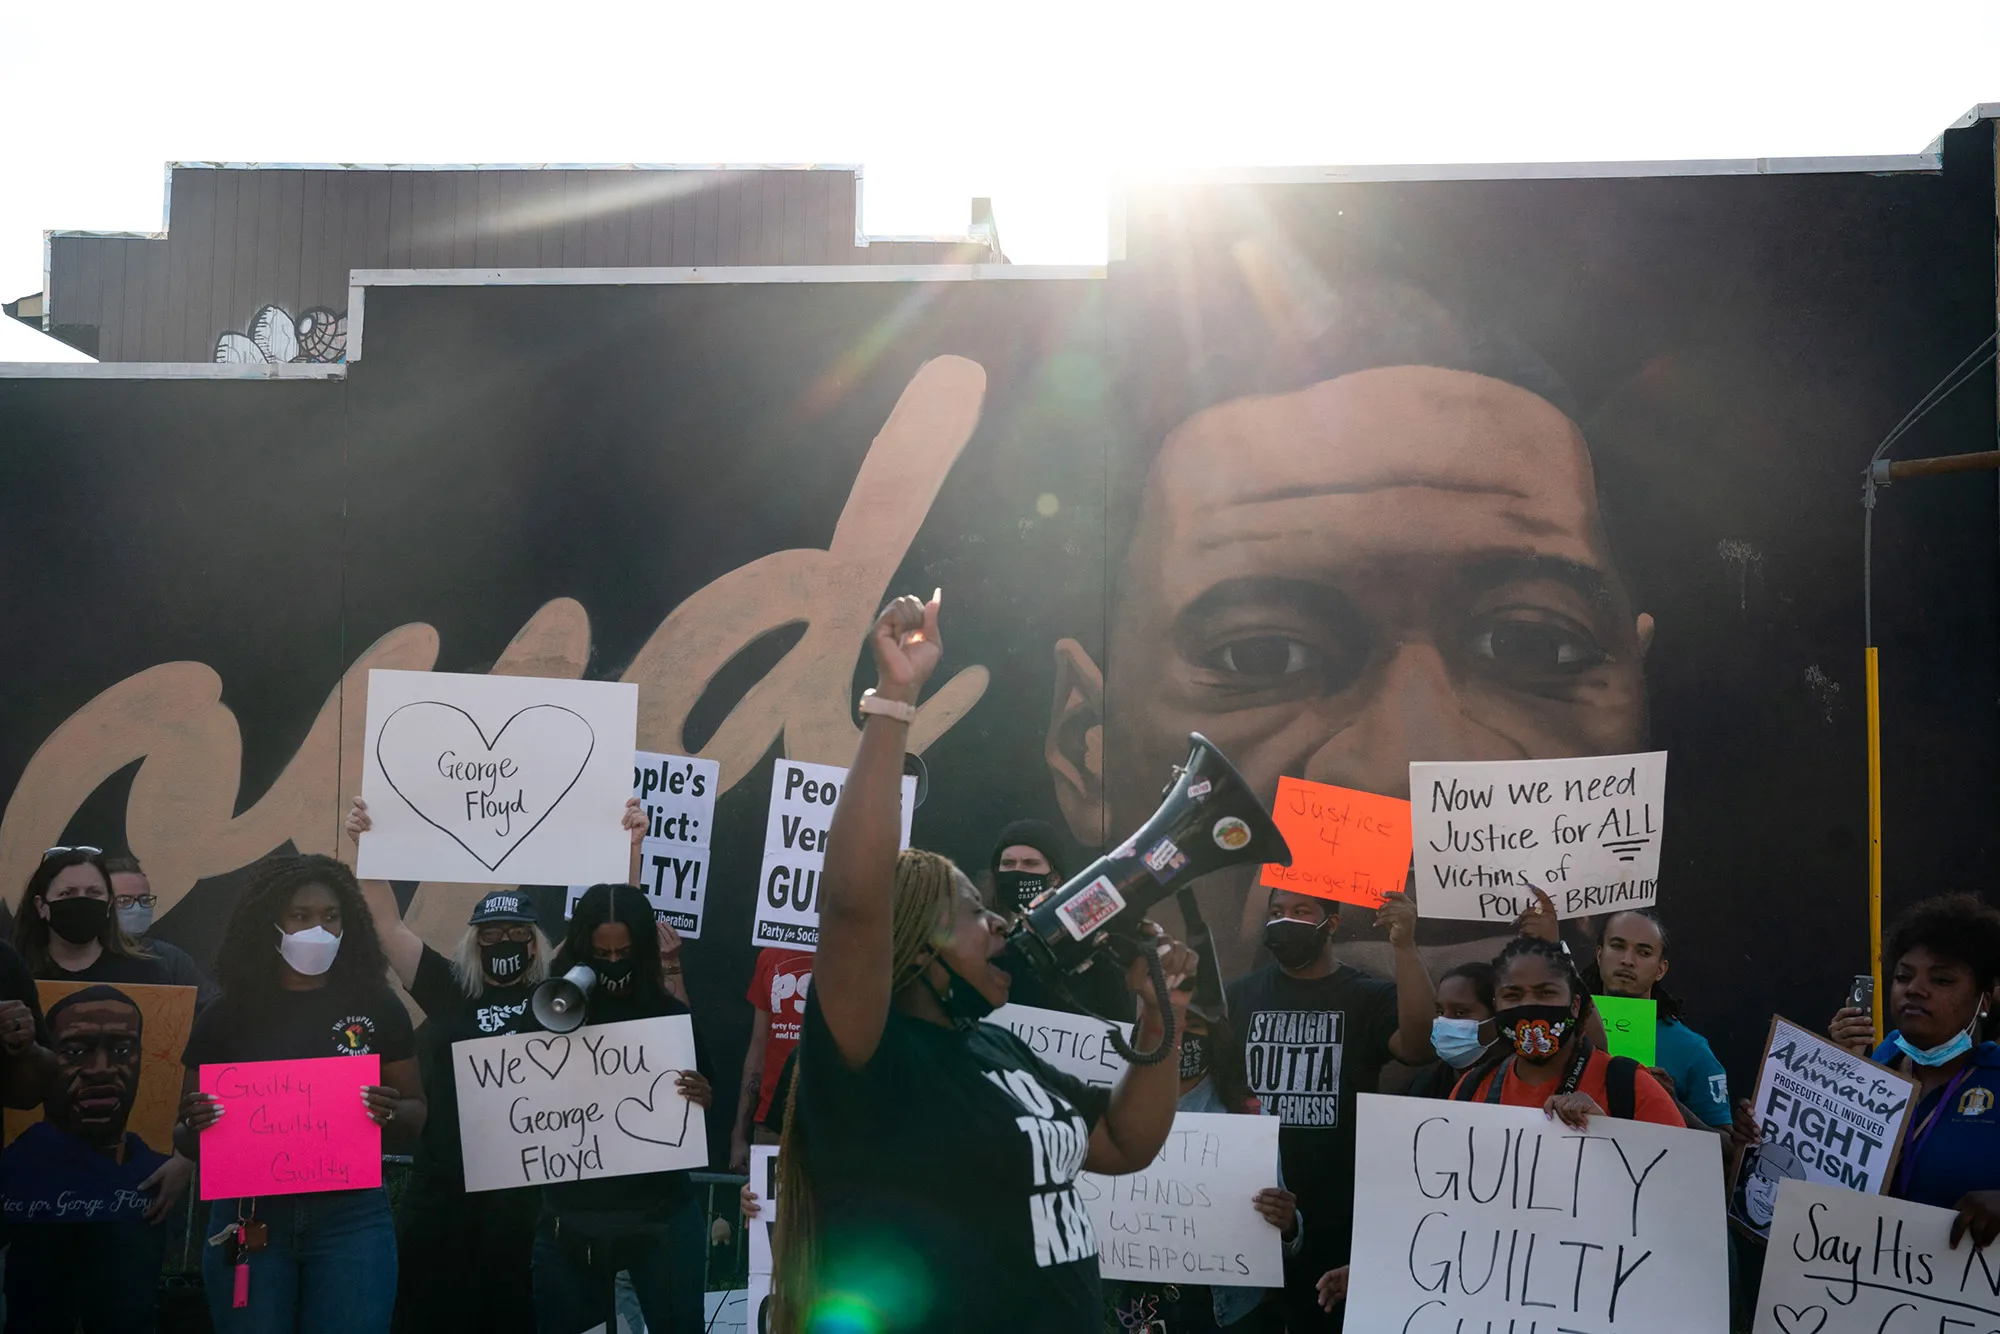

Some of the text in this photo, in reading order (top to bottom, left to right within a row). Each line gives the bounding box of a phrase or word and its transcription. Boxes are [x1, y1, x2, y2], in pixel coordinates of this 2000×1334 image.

[438, 751, 518, 796] George
[1432, 767, 1636, 813] Now we need
[466, 789, 529, 837] Floyd
[1287, 788, 1393, 837] Justice
[1430, 804, 1656, 852] Justice for ALL
[1319, 827, 1340, 856] 4
[1269, 864, 1345, 893] George
[1433, 853, 1571, 889] Victims of
[485, 896, 519, 909] VOTING
[1567, 879, 1660, 913] BRUTALITY
[761, 922, 785, 942] Party
[784, 928, 796, 942] for
[492, 954, 521, 976] VOTE
[1252, 1013, 1340, 1043] STRAIGHT
[469, 1035, 650, 1088] We You
[1250, 1045, 1333, 1092] OUTTA
[1768, 1041, 1908, 1124] Ahmaud
[1808, 1047, 1896, 1099] Justice for
[216, 1066, 312, 1107] Guilty
[1774, 1072, 1885, 1137] PROSECUTE ALL INVOLVED
[250, 1105, 328, 1141] Guilty
[509, 1096, 604, 1147] George
[1277, 1095, 1335, 1125] GENESIS
[1766, 1086, 1883, 1168] FIGHT
[271, 1151, 349, 1183] Guilty
[521, 1135, 604, 1182] Floyd
[1414, 1117, 1668, 1237] GUILTY
[1761, 1117, 1869, 1194] RACISM
[28, 1199, 51, 1218] for
[56, 1191, 105, 1217] George
[1081, 1171, 1211, 1208] STANDS
[1109, 1211, 1197, 1239] WITH
[1409, 1211, 1652, 1323] GUILTY
[1793, 1203, 1861, 1305] Say
[1873, 1216, 1933, 1285] His
